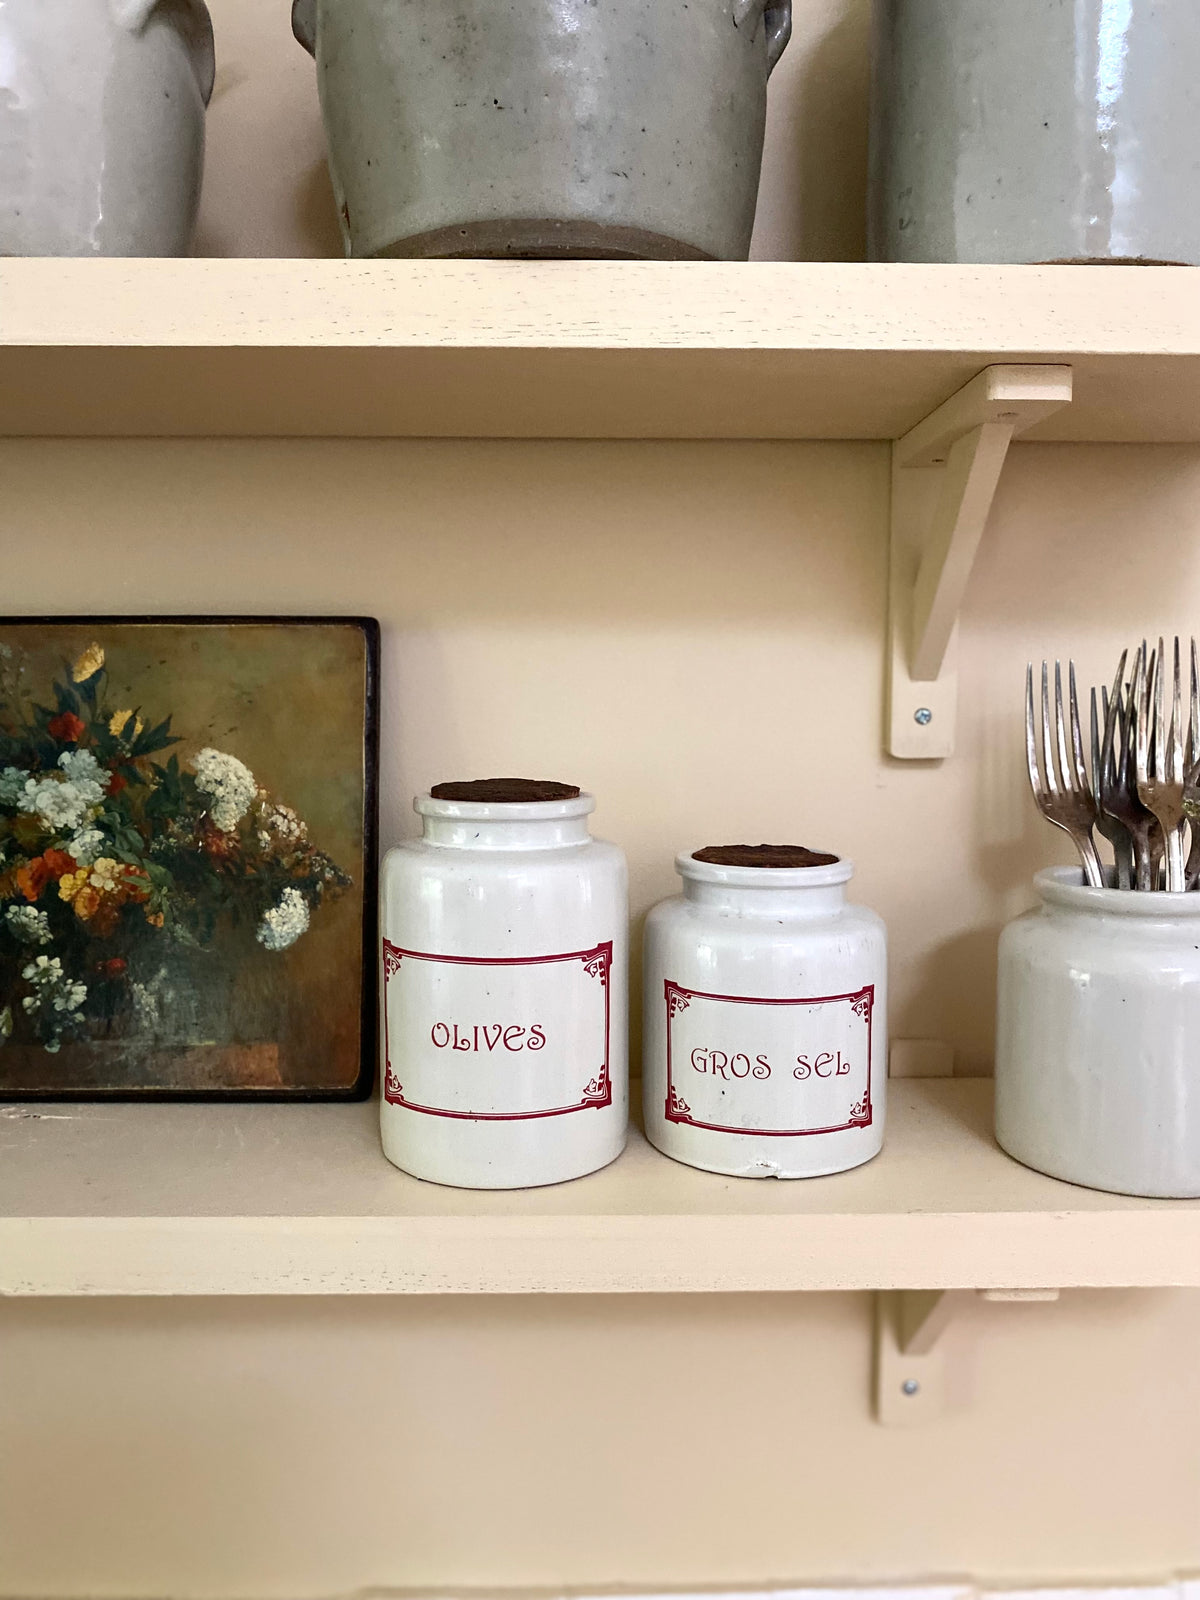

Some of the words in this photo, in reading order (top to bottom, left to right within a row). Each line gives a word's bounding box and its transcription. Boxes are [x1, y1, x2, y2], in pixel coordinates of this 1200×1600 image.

[431, 1022, 547, 1053] OLIVES
[690, 1047, 772, 1080] GROS
[793, 1051, 851, 1079] SEL
